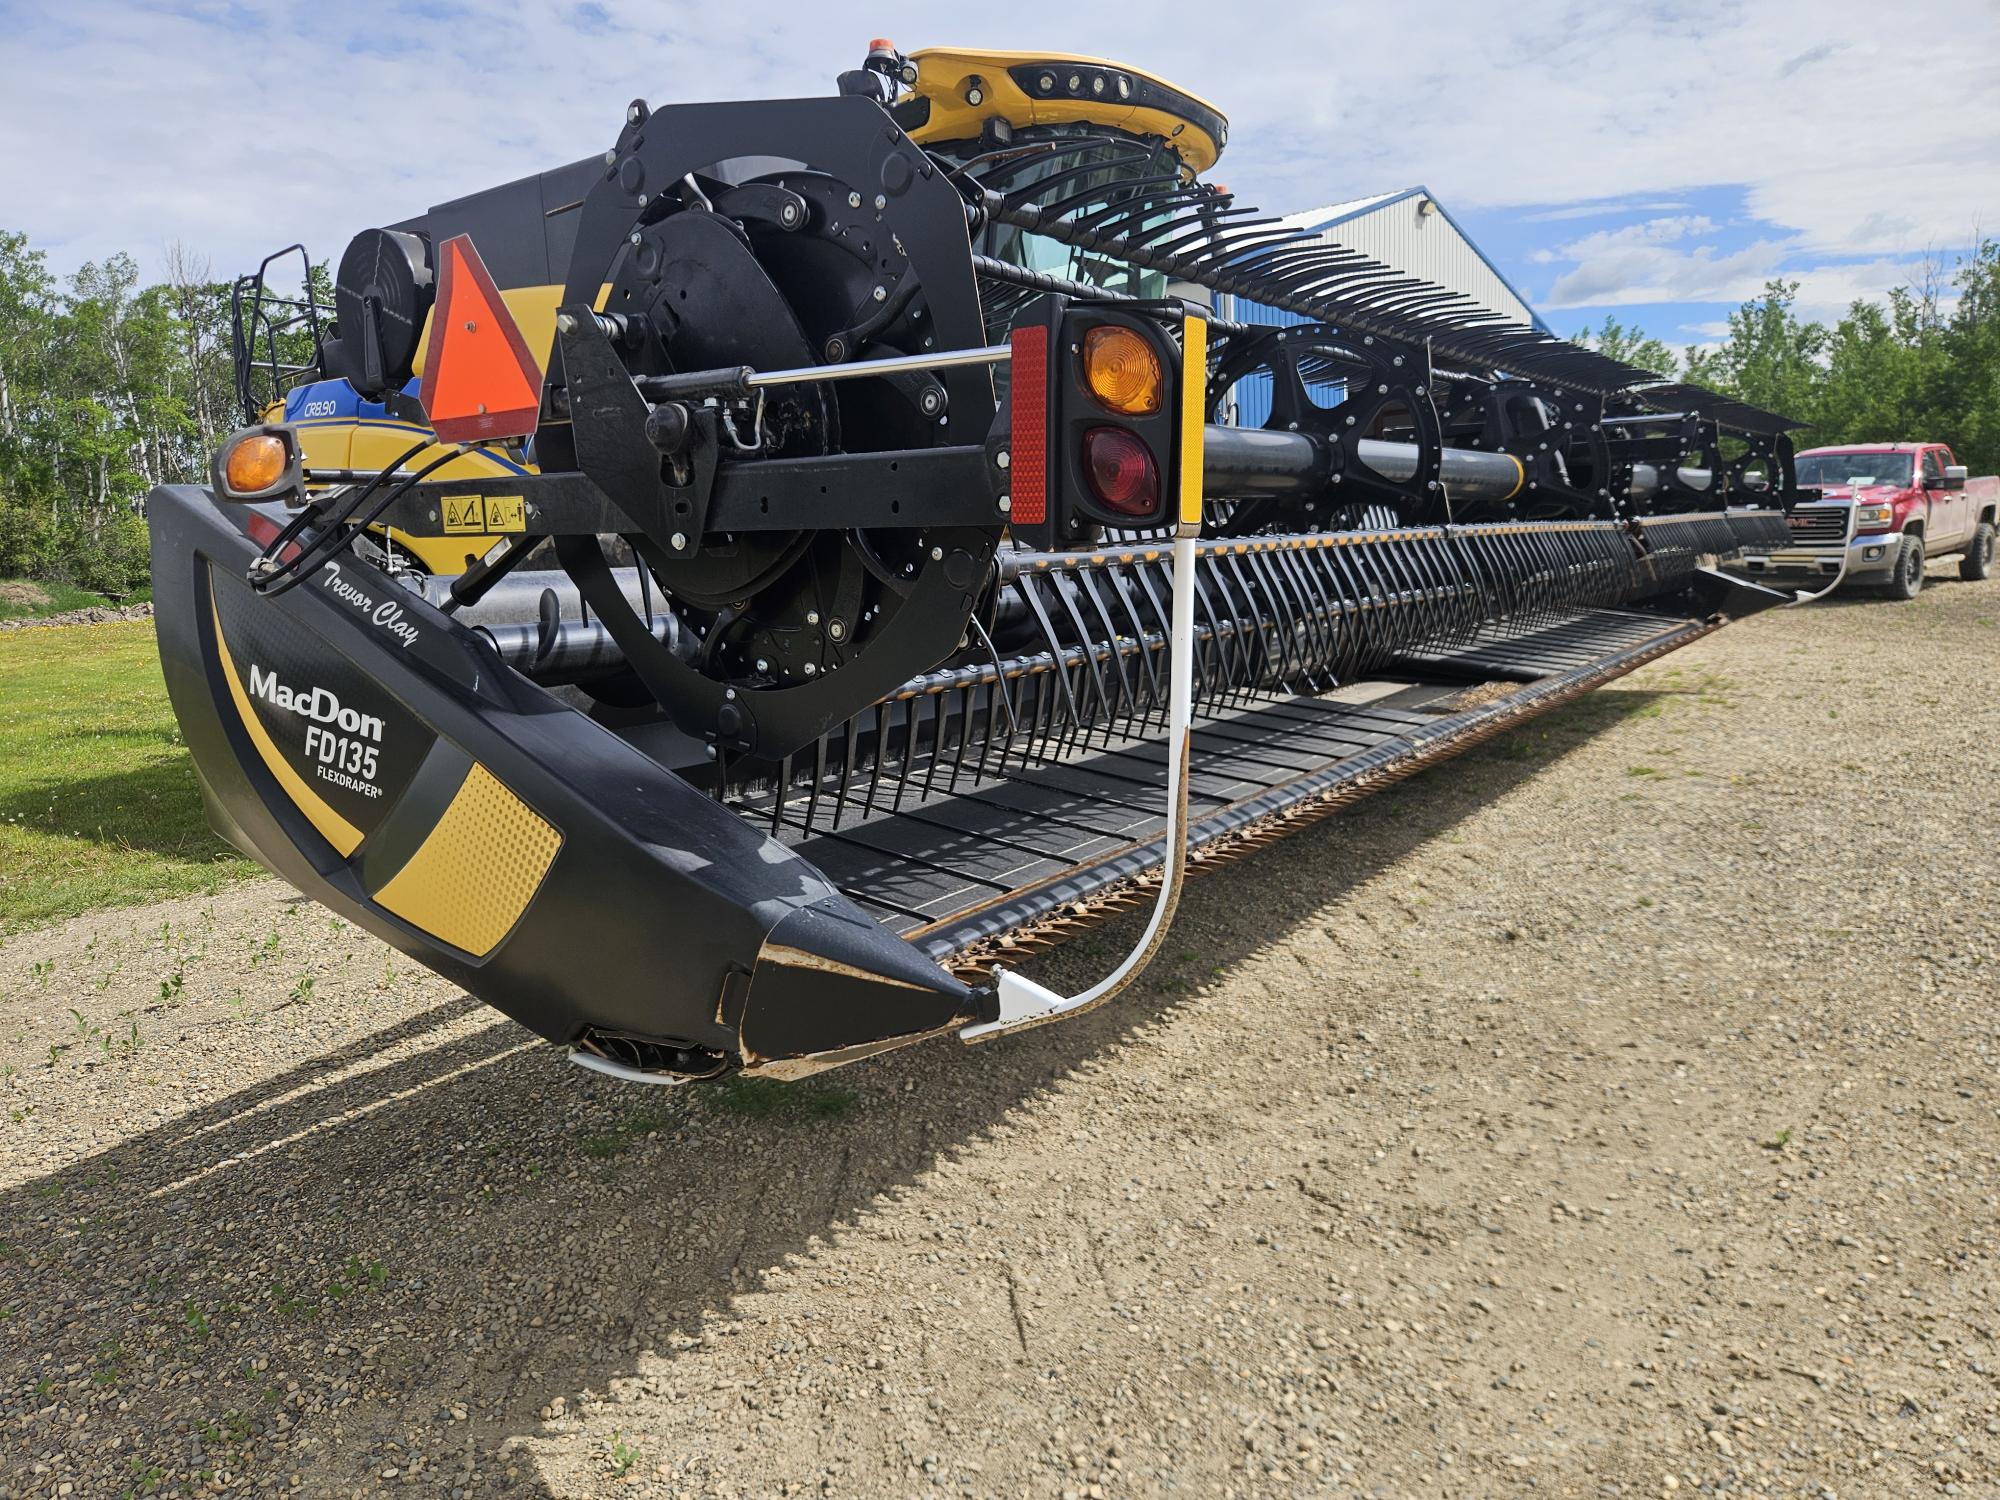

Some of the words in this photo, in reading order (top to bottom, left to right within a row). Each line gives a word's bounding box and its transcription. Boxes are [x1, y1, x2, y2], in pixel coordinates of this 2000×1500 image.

[304, 400, 336, 417] CR8.90
[323, 562, 372, 612] Trevor
[372, 600, 419, 647] Clay
[304, 725, 380, 780] FD135
